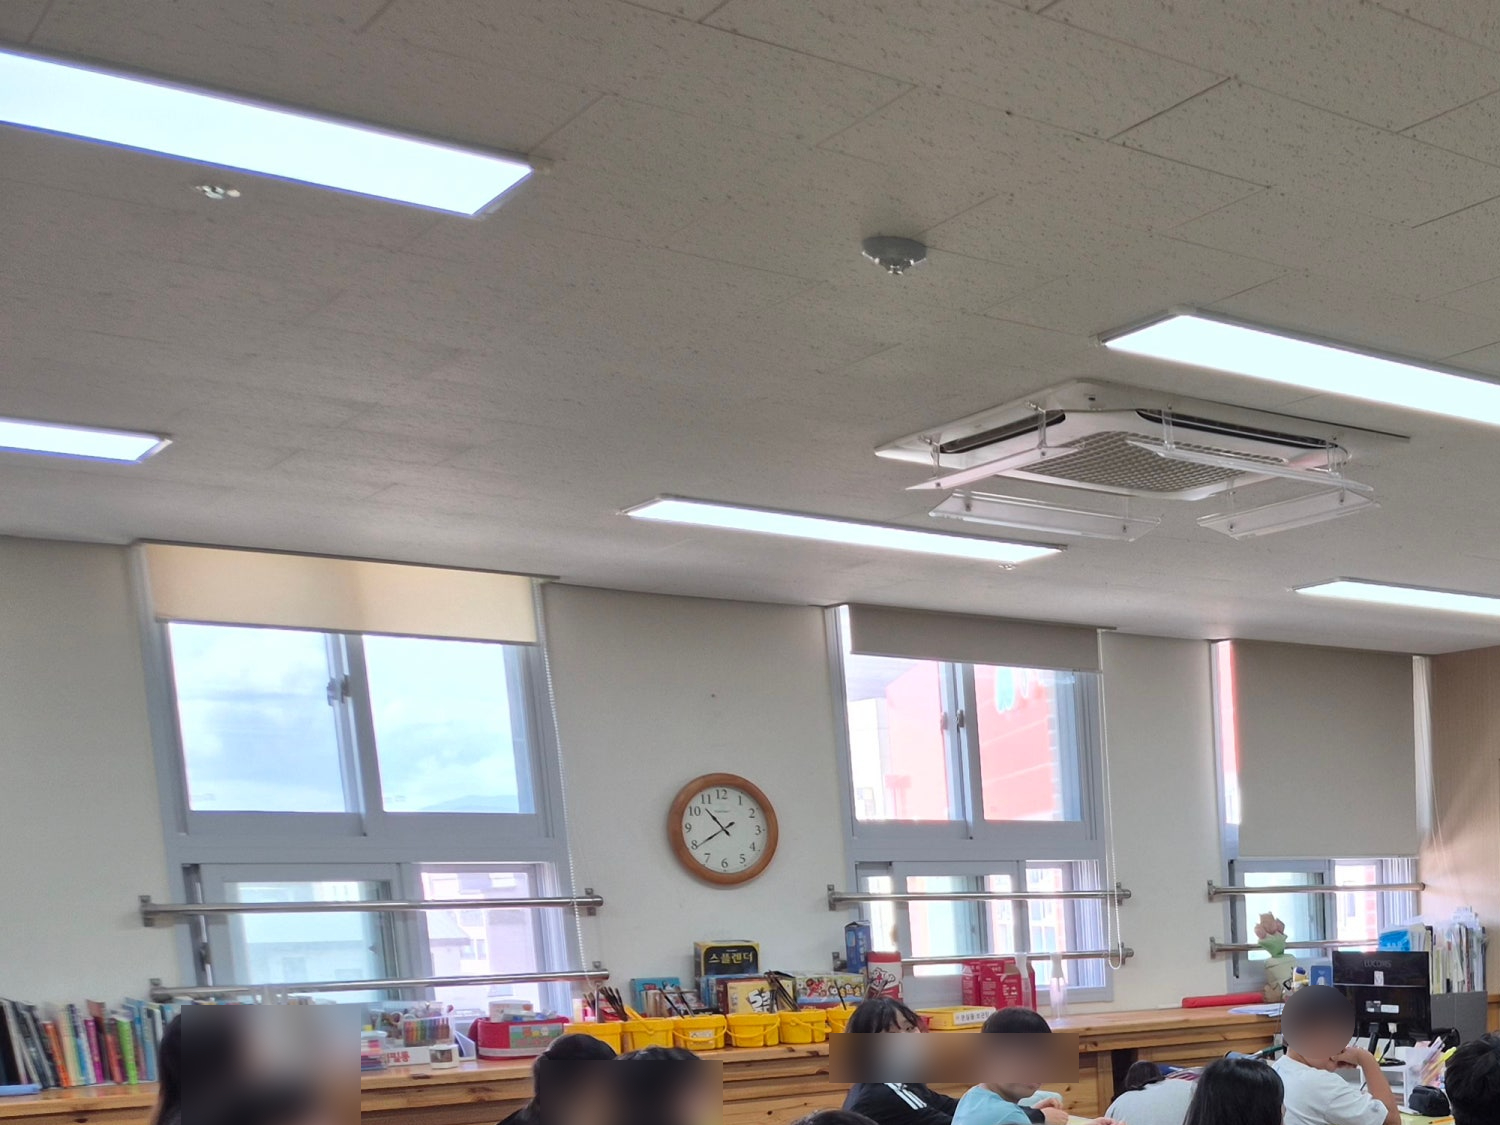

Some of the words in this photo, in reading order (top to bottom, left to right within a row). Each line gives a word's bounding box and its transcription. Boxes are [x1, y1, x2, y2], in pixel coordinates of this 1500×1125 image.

[701, 795, 712, 804] 11
[715, 789, 728, 800] 12
[738, 796, 743, 806] 1
[689, 806, 701, 816] 10
[749, 808, 755, 818] 2
[685, 823, 692, 833] 9
[755, 825, 762, 836] 3
[691, 840, 698, 850] 8
[749, 842, 756, 852] 4
[704, 853, 711, 863] 7
[721, 858, 728, 868] 6
[739, 854, 746, 864] 5
[708, 951, 753, 965] 스플렌더
